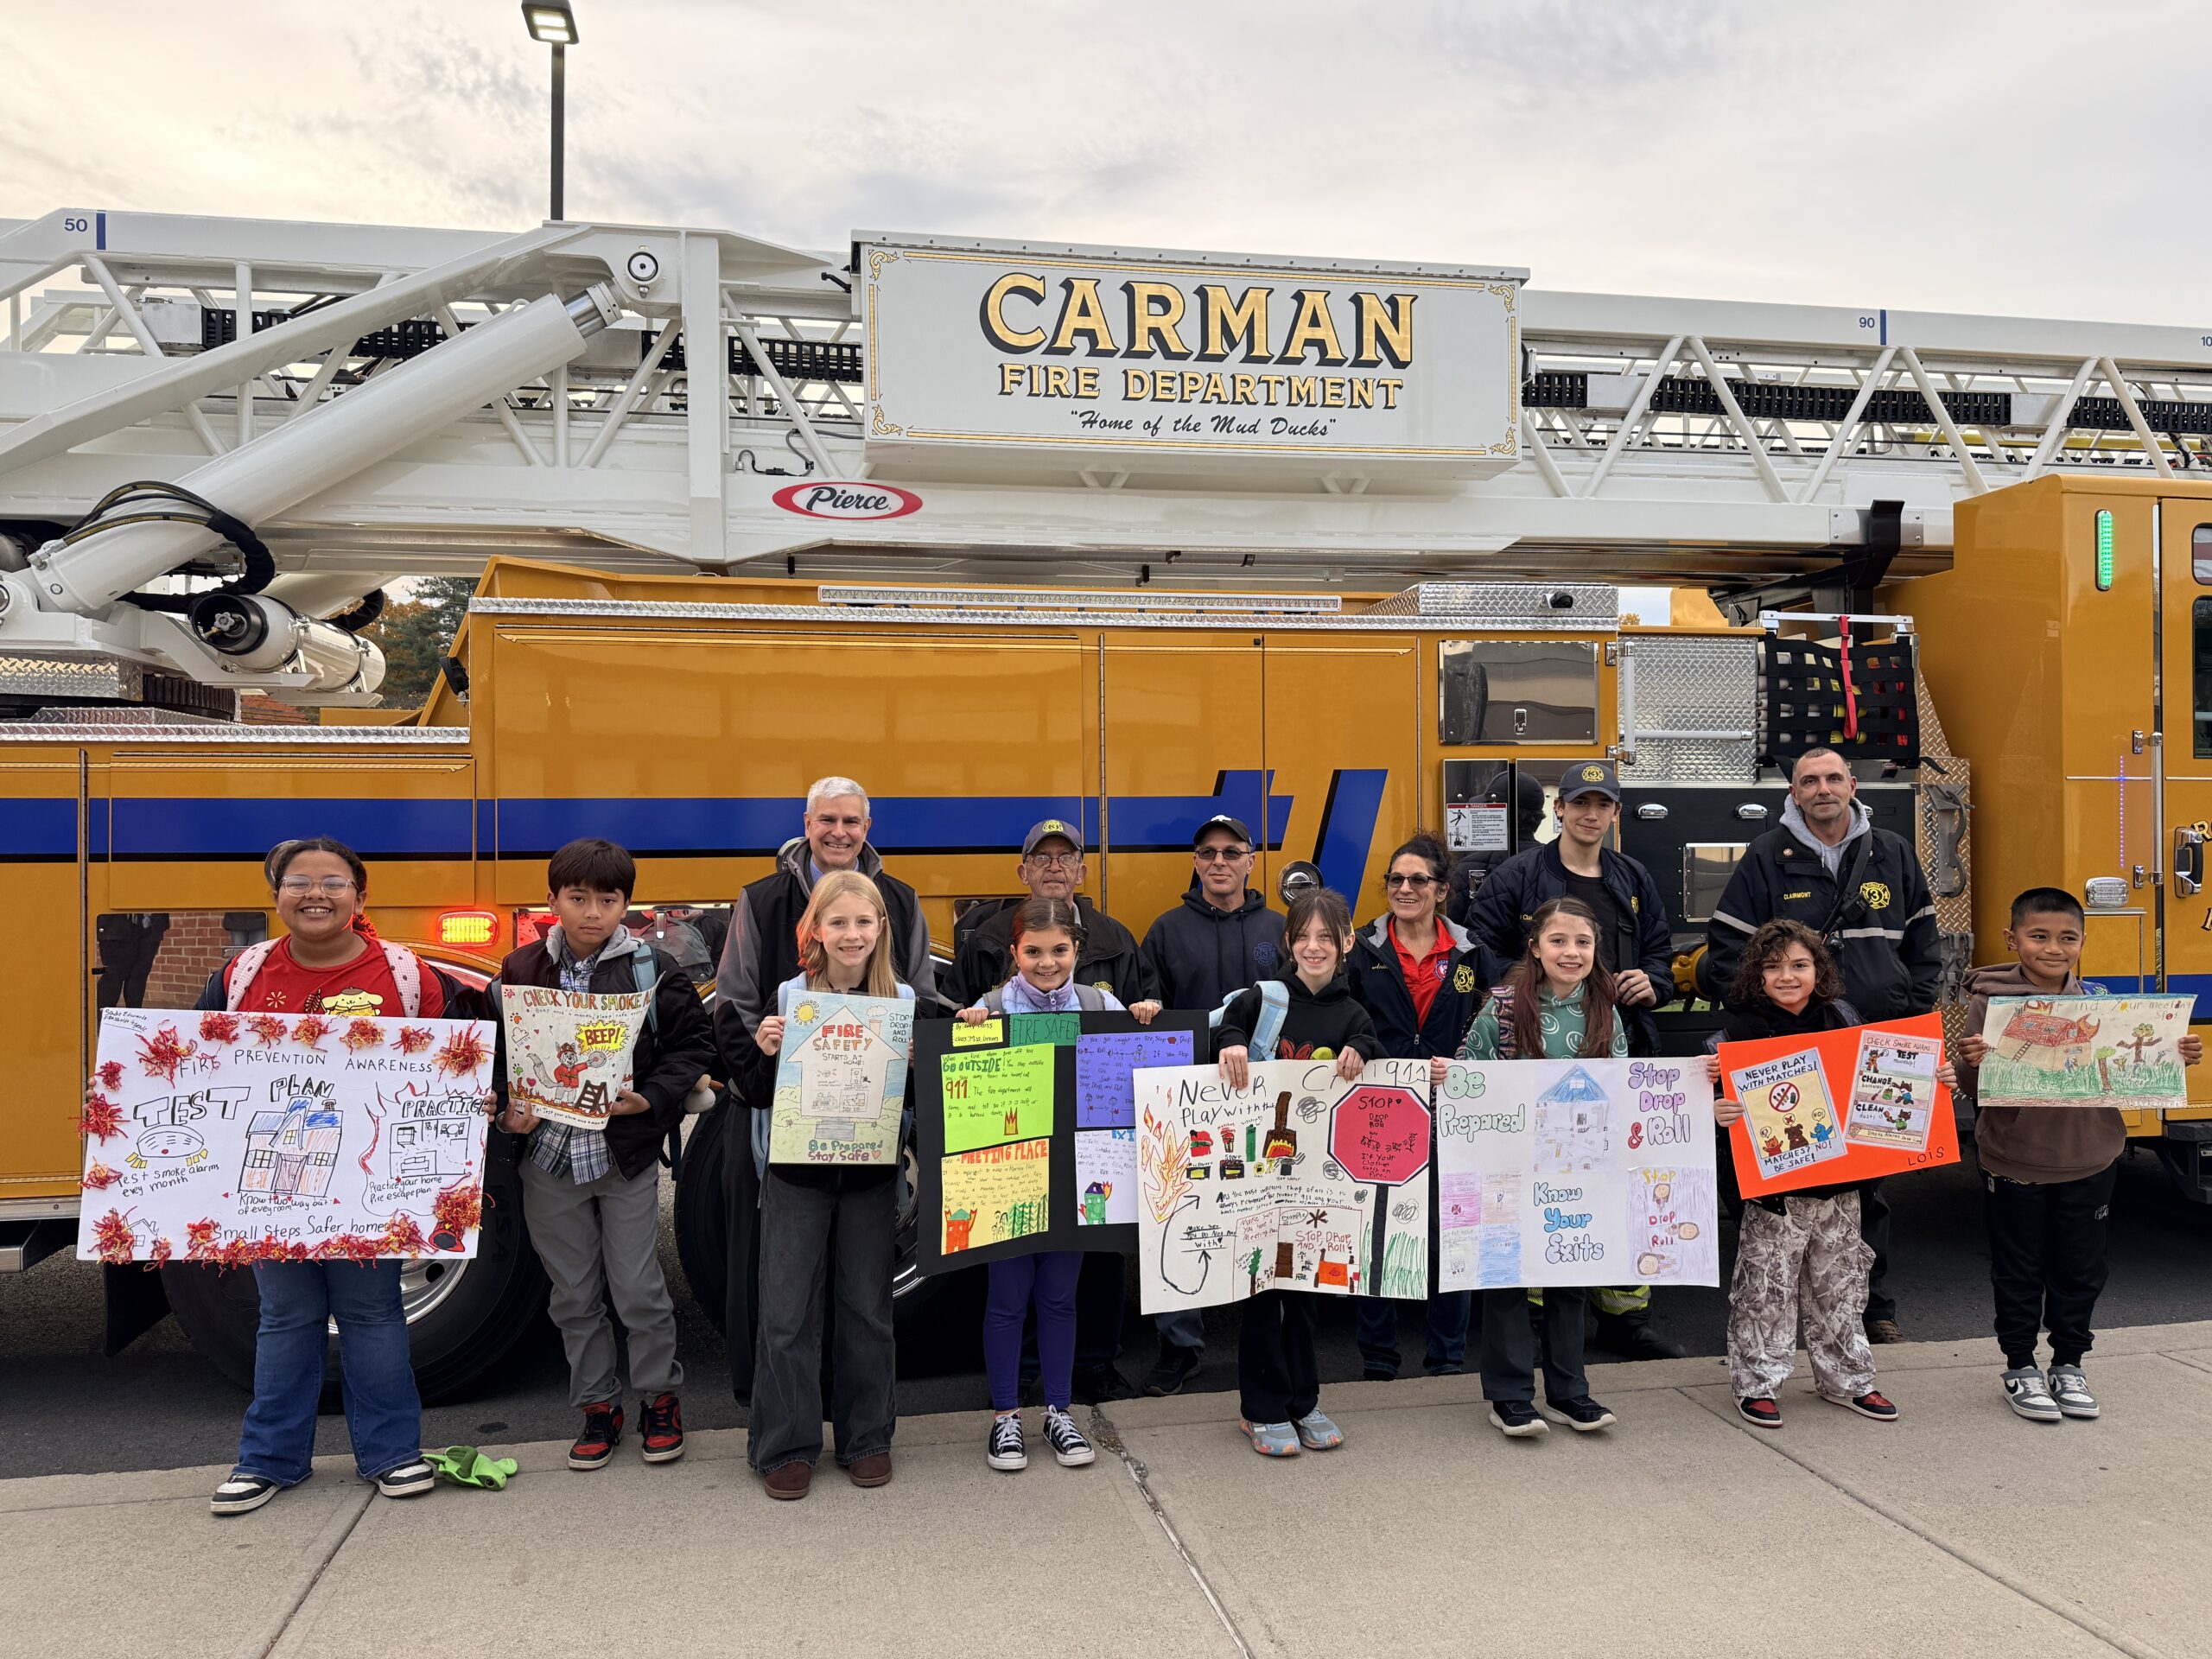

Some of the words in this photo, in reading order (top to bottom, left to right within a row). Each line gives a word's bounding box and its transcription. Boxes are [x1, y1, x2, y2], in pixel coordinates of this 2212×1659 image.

[64, 218, 88, 232] 50
[980, 271, 1420, 370] CARMAN
[1859, 316, 1875, 328] 90
[998, 362, 1102, 400] FIRE
[1121, 368, 1406, 410] DEPARTMENT
[1142, 416, 1164, 435] of
[1173, 416, 1202, 434] the
[1211, 415, 1262, 435] Mud
[805, 486, 889, 512] Pierce
[1783, 891, 1812, 900] CLAIRMONT
[1869, 888, 1880, 901] 3
[1458, 972, 1466, 983] 3
[523, 989, 563, 1007] CHECK
[563, 992, 599, 1010] YOUR
[601, 993, 642, 1011] SMOKE
[2056, 1001, 2098, 1012] Find
[584, 1027, 621, 1046] BEEP!
[822, 1024, 864, 1039] FIRE
[1011, 1018, 1041, 1046] FIRE
[812, 1037, 873, 1052] SAFETY
[1866, 1037, 1891, 1047] CHECK
[1893, 1039, 1912, 1049] SMOKE
[822, 1052, 849, 1062] STARTS
[1897, 1049, 1919, 1059] TEST
[180, 1057, 221, 1077] FIRE
[234, 1049, 326, 1066] PREVENTION
[345, 1058, 432, 1072] AWARENESS
[943, 1061, 957, 1072] GO
[1745, 1067, 1778, 1081] NEVER
[1782, 1056, 1807, 1071] PLAY
[1385, 1061, 1426, 1087] 911
[1443, 1065, 1485, 1099] Be
[1628, 1062, 1680, 1090] Stop
[1738, 1078, 1764, 1092] WITH
[1766, 1061, 1817, 1084] MATCHES!
[1861, 1075, 1892, 1085] CHANGE
[270, 1073, 334, 1102] PLAN
[973, 1085, 982, 1096] The
[133, 1086, 251, 1128] TEST
[1358, 1096, 1393, 1109] STOP
[1639, 1090, 1685, 1113] Drop
[1855, 1103, 1884, 1113] CLEAN
[1440, 1103, 1525, 1142] Prepared
[1112, 1129, 1135, 1141] EXI
[1628, 1122, 1643, 1149] &
[1647, 1113, 1690, 1146] Roll
[808, 1139, 828, 1151] Be
[831, 1139, 884, 1154] Prepared
[961, 1145, 1012, 1165] MEETING
[1014, 1140, 1047, 1160] PLACE
[1764, 1147, 1810, 1166] MATCHES?
[1815, 1141, 1833, 1153] NO!
[808, 1150, 835, 1163] Stay
[839, 1150, 870, 1162] Safe
[1787, 1154, 1816, 1168] SAFE!
[154, 1166, 186, 1179] smoke
[189, 1164, 219, 1173] alarms
[1643, 1169, 1676, 1184] Stop
[149, 1176, 188, 1192] month
[369, 1179, 399, 1193] Practice
[399, 1178, 419, 1193] your
[420, 1176, 442, 1185] home
[238, 1192, 267, 1207] Know
[386, 1189, 415, 1201] escape
[416, 1187, 432, 1199] plan
[1533, 1182, 1582, 1207] Know
[1543, 1207, 1592, 1232] Your
[1649, 1211, 1675, 1226] Drop
[214, 1224, 257, 1241] Small
[307, 1215, 344, 1235] Safer
[1545, 1233, 1605, 1264] Exits
[1651, 1236, 1674, 1246] Roll
